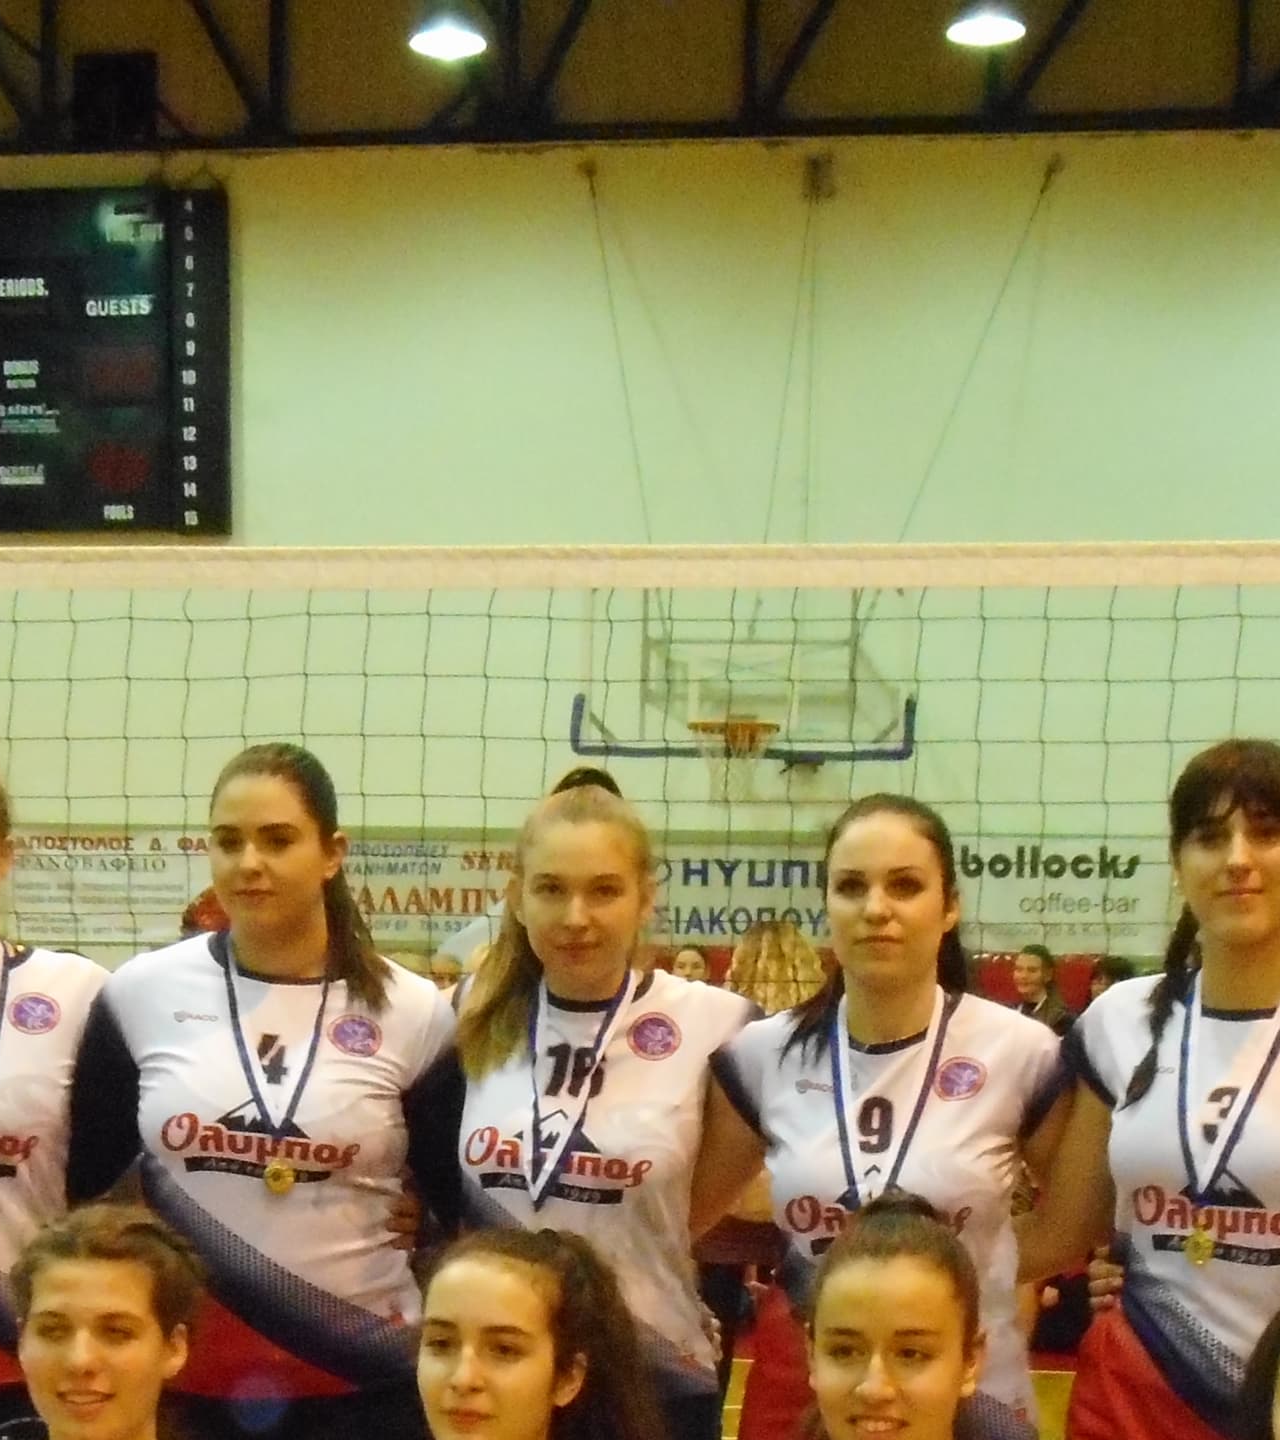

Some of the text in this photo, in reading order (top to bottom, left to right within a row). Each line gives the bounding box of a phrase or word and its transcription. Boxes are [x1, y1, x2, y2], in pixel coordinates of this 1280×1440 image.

[185, 282, 194, 297] 7
[85, 299, 152, 317] GUESTS
[183, 397, 195, 412] 11
[182, 426, 197, 441] 12
[16, 836, 134, 850] ΑΠΟΣΤΟΛΟΣ
[960, 845, 1141, 879] bollocks
[351, 885, 505, 914] ΑΛΑΜΠΥ
[1019, 892, 1141, 914] coffee-bar
[652, 906, 830, 936] ΣΙΑΚΟΠΟΥ
[257, 1033, 288, 1085] 4
[856, 1096, 894, 1154] 9
